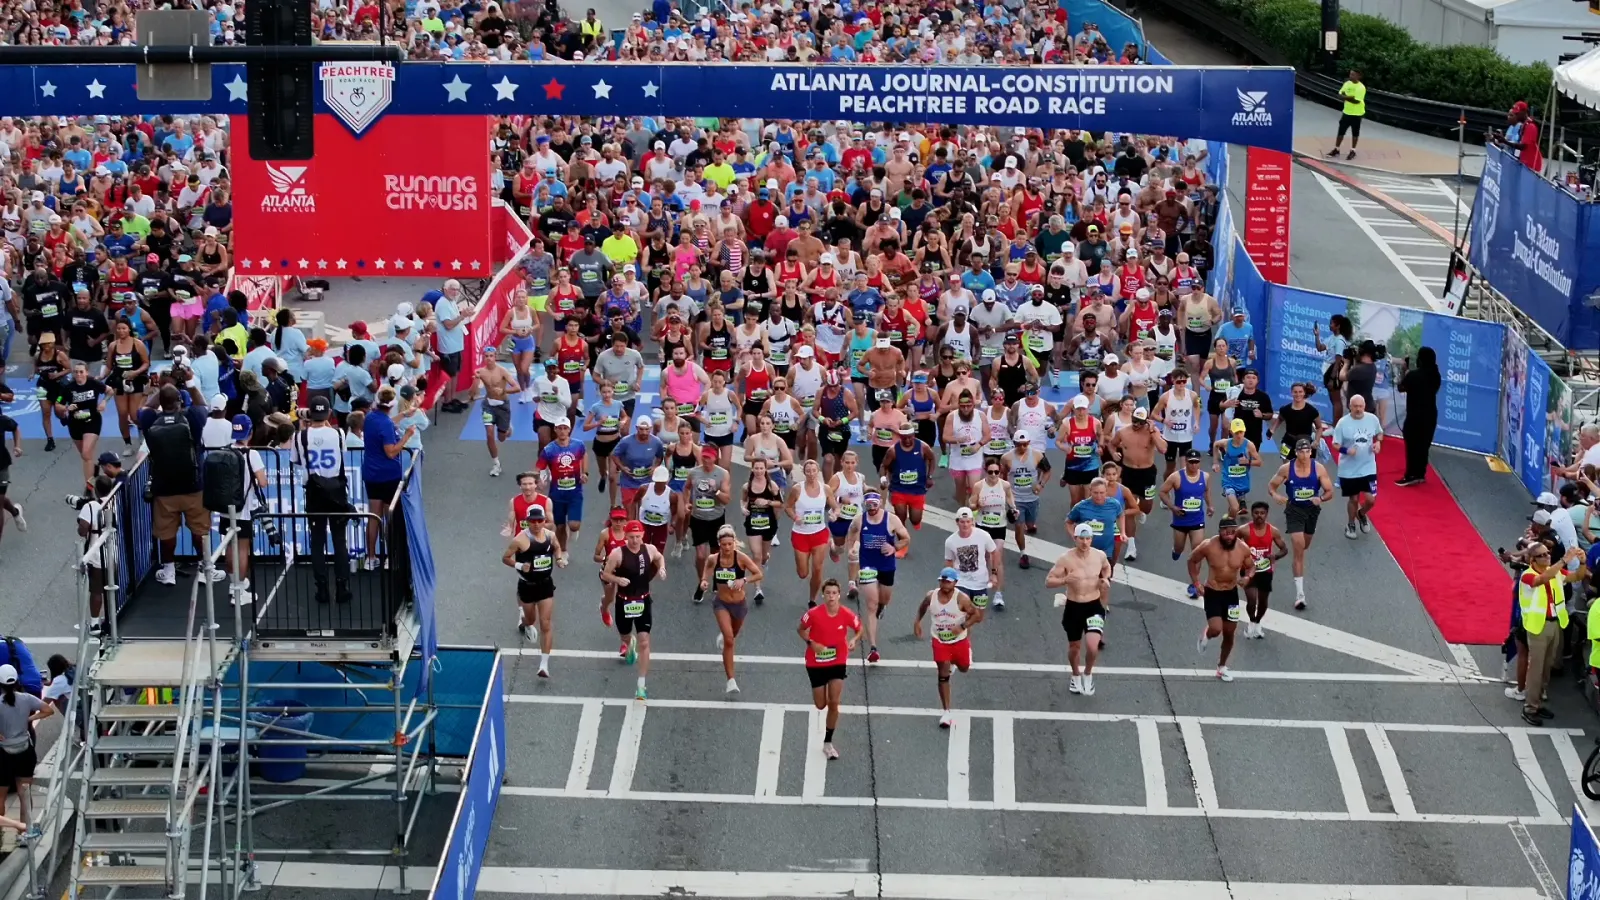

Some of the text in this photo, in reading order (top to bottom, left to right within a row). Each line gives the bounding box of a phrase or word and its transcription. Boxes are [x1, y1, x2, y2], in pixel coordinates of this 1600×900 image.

[321, 66, 393, 78] PEACHTREE
[770, 72, 1174, 93] ATLANTA JOURNAL-CONSTITUTION
[839, 96, 1106, 115] PEACHTREE ROAD RACE
[1231, 112, 1272, 122] ATLANTA
[383, 174, 477, 192] RUNNING
[261, 195, 316, 207] ATLANTA
[386, 192, 478, 211] CITY USA
[1536, 223, 1560, 260] Atlanta
[1511, 230, 1572, 297] Journal-Constitution
[1283, 300, 1332, 320] Substance
[1283, 312, 1331, 332] Substace
[1450, 330, 1473, 344] Soul
[1449, 343, 1471, 357] Soul
[1448, 356, 1470, 370] Soul
[1447, 369, 1469, 384] Soul
[1446, 382, 1468, 396] Soul
[1445, 395, 1467, 409] Soul
[1445, 408, 1467, 422] Soul
[1074, 435, 1091, 443] RED
[307, 449, 336, 469] 25
